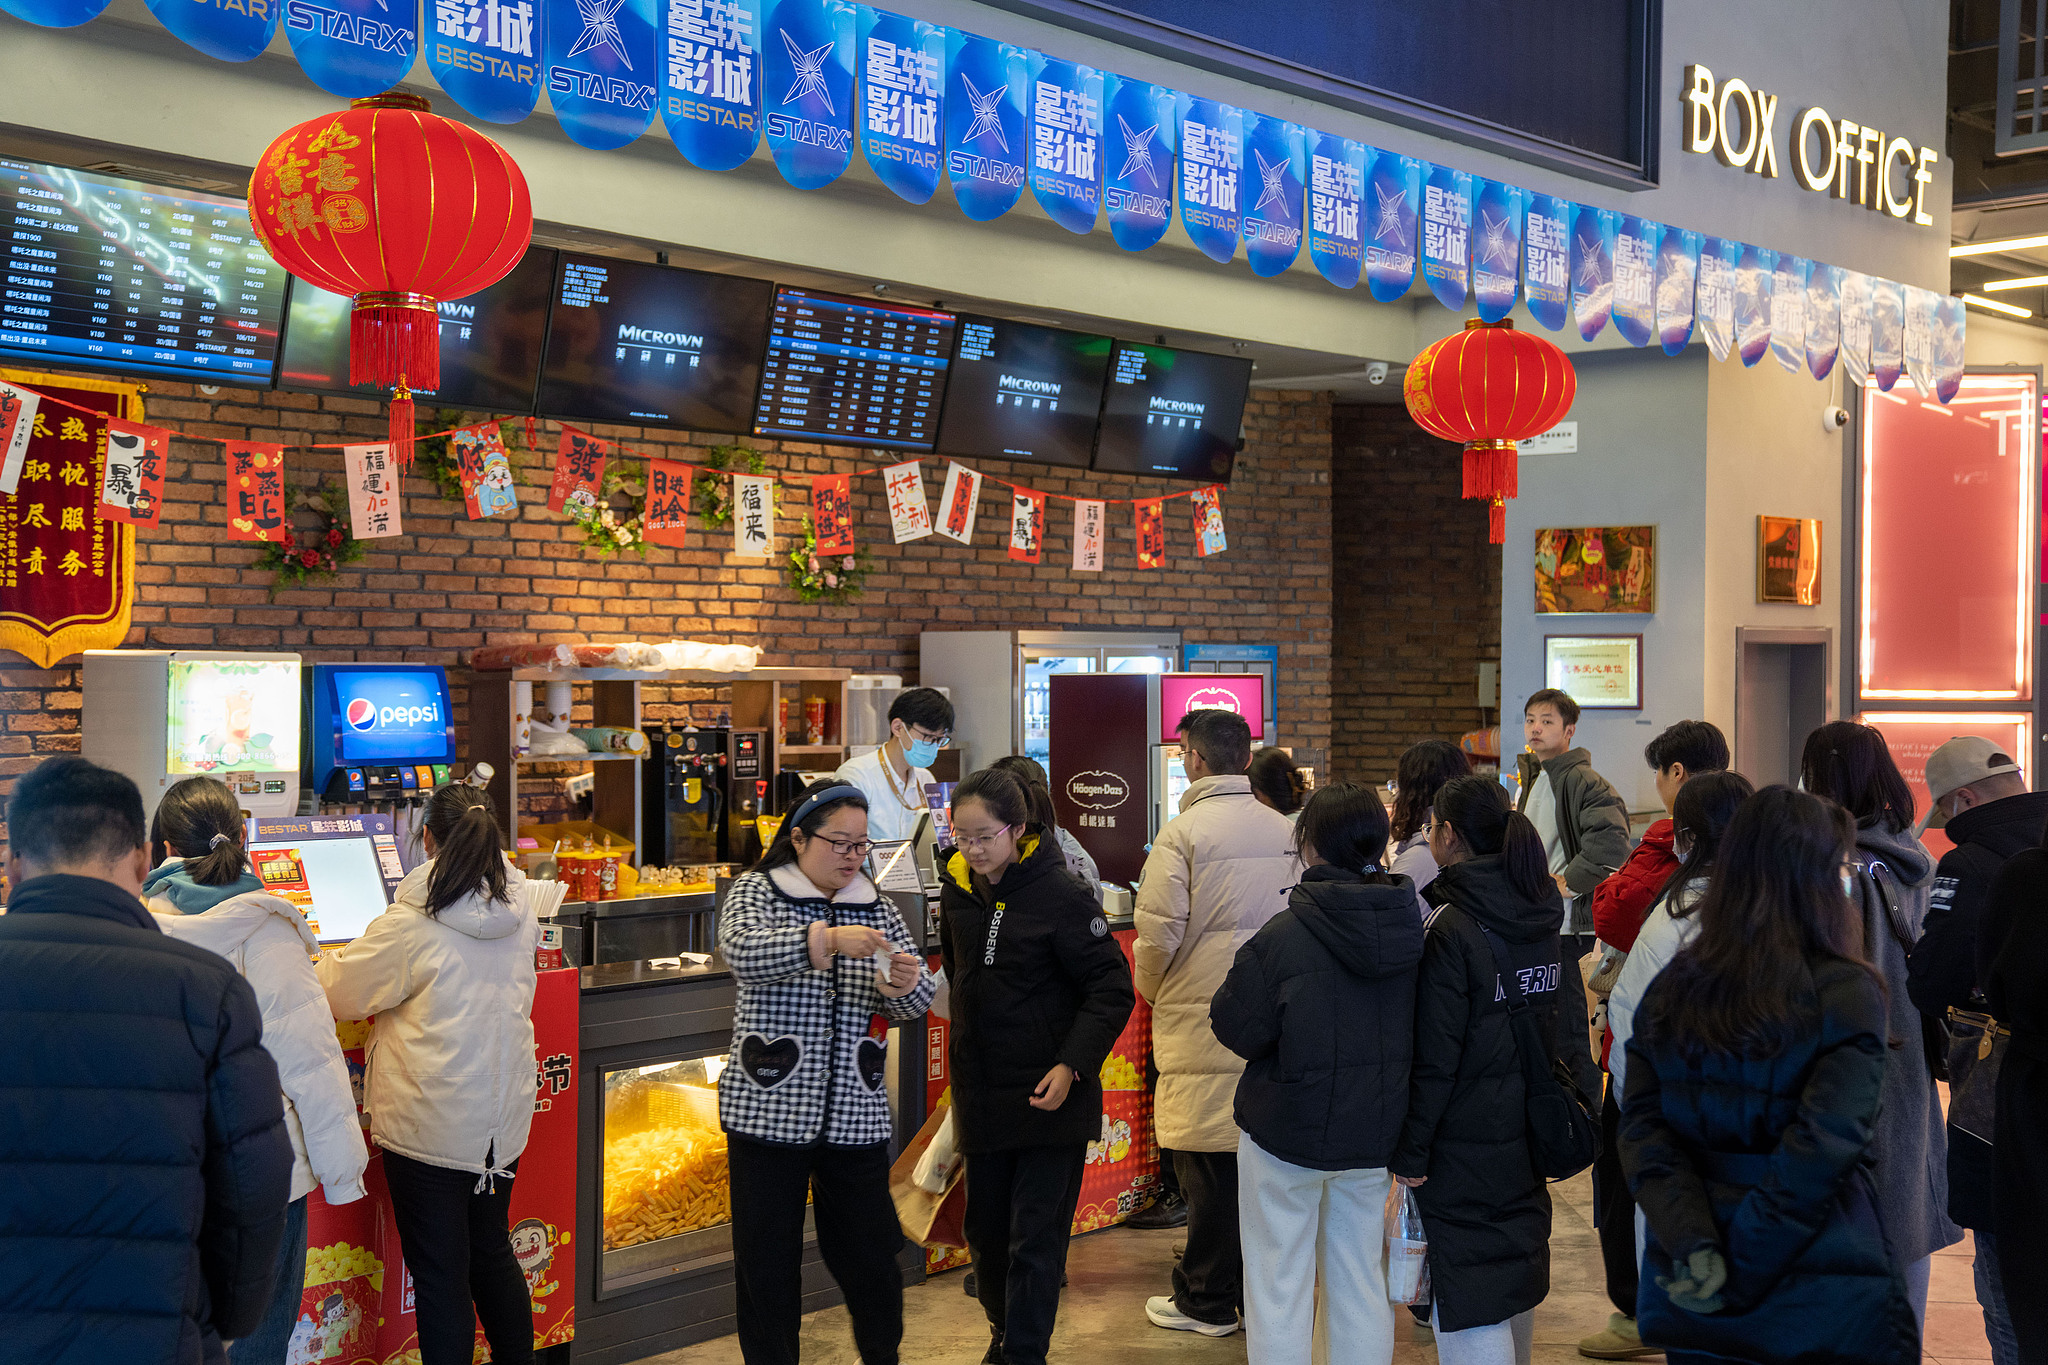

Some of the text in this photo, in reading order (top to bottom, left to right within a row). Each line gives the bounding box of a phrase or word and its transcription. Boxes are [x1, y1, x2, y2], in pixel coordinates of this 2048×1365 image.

[436, 44, 534, 86] BESTAR
[668, 38, 752, 108] 影城
[668, 96, 755, 132] BESTAR
[867, 85, 937, 147] 影城
[869, 139, 937, 170] BESTAR
[1035, 125, 1096, 182] 影城
[1686, 64, 1938, 226] BOX OFFICE
[1036, 175, 1096, 204] BESTAR
[1184, 161, 1237, 213] 影城
[1185, 208, 1237, 233] BESTAR
[1313, 236, 1360, 261] BESTAR
[1426, 262, 1467, 286] BESTAR
[21, 413, 54, 576] 尽职尽责
[57, 417, 89, 577] 热忱服务
[742, 484, 767, 542] 福来
[667, 519, 686, 530] LUCK
[380, 703, 437, 727] pepsi
[1072, 783, 1123, 797] Häagen-Dazs
[259, 824, 309, 835] BESTAR
[984, 901, 1006, 967] BOSIDENG
